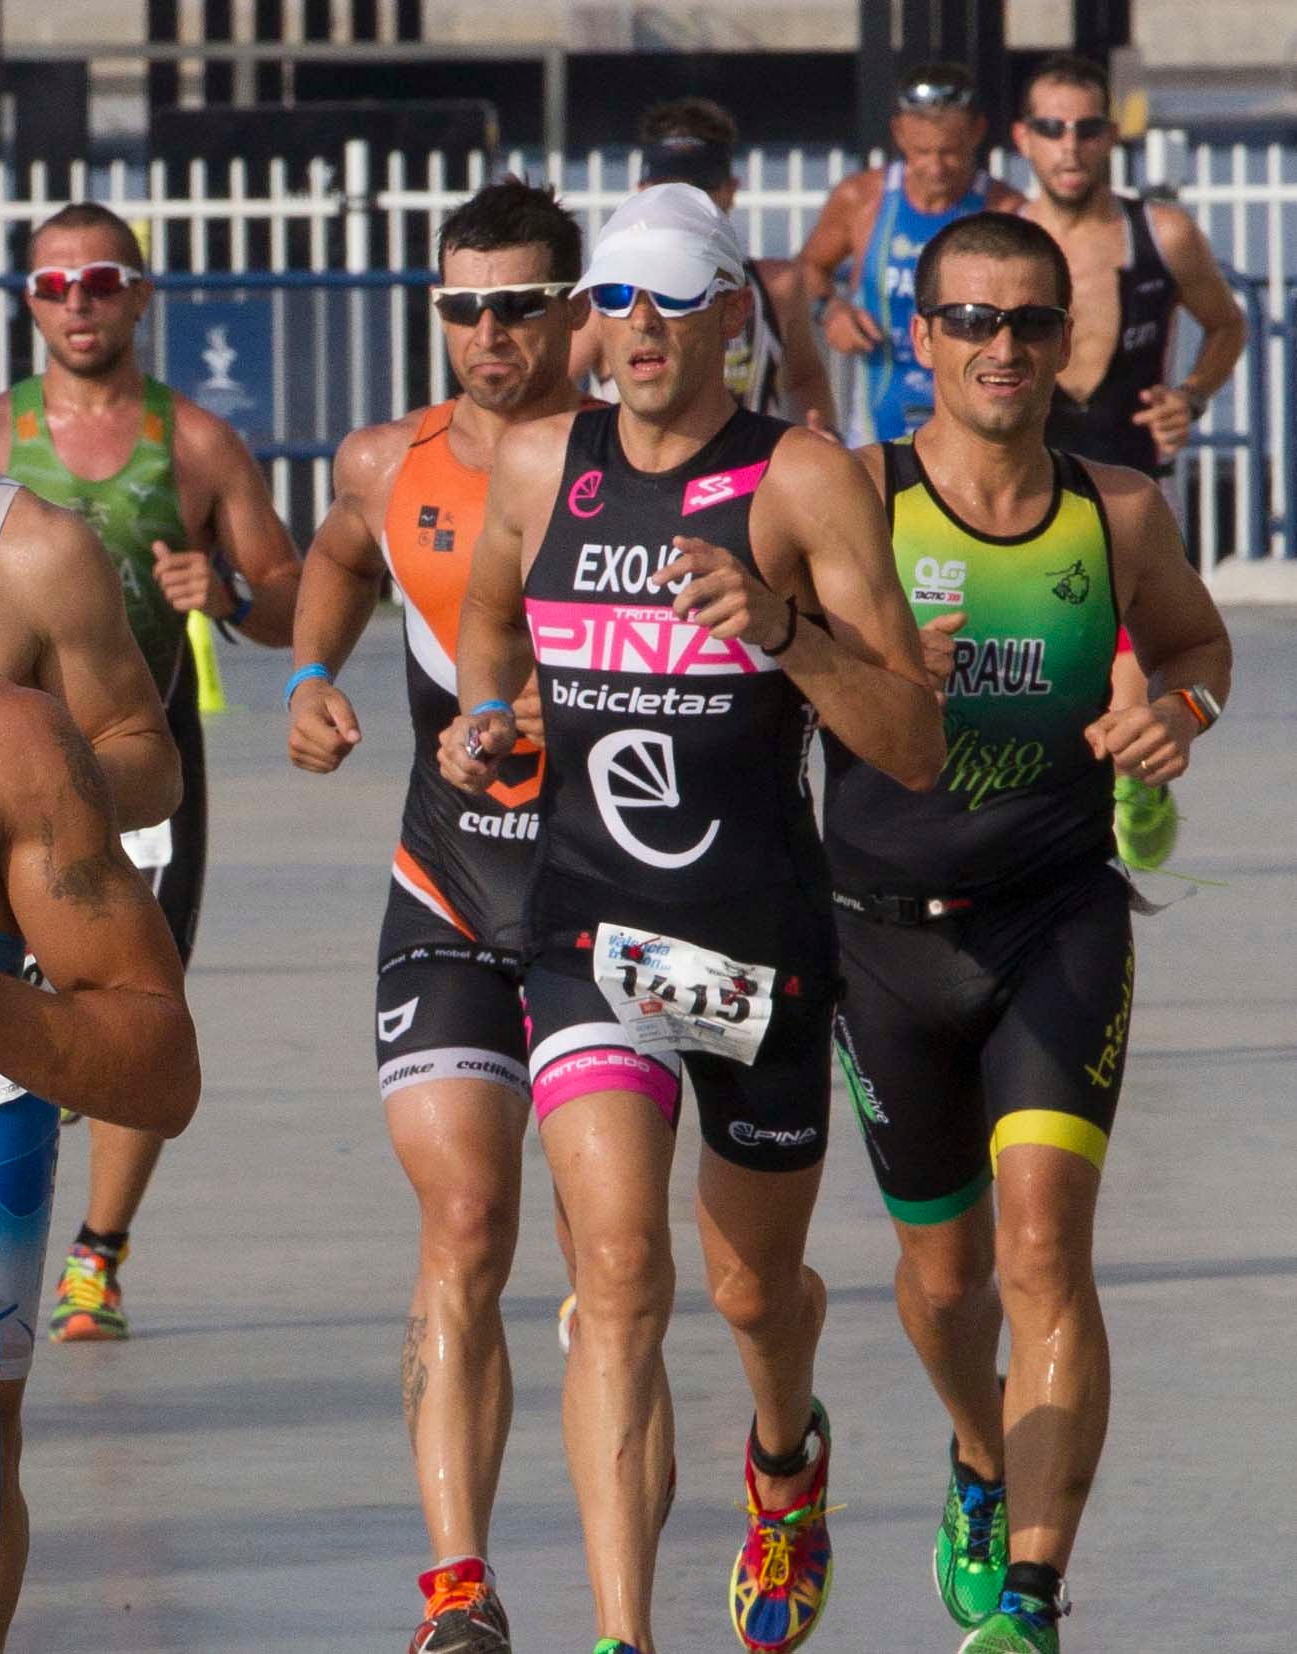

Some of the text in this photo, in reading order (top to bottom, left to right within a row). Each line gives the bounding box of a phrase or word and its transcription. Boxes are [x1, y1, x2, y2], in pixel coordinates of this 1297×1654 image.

[530, 616, 758, 675] PINA
[947, 637, 1052, 696] RAUL
[552, 679, 734, 715] bicicletas
[456, 1060, 520, 1083] catlike
[540, 1055, 651, 1087] TRITOLEDO
